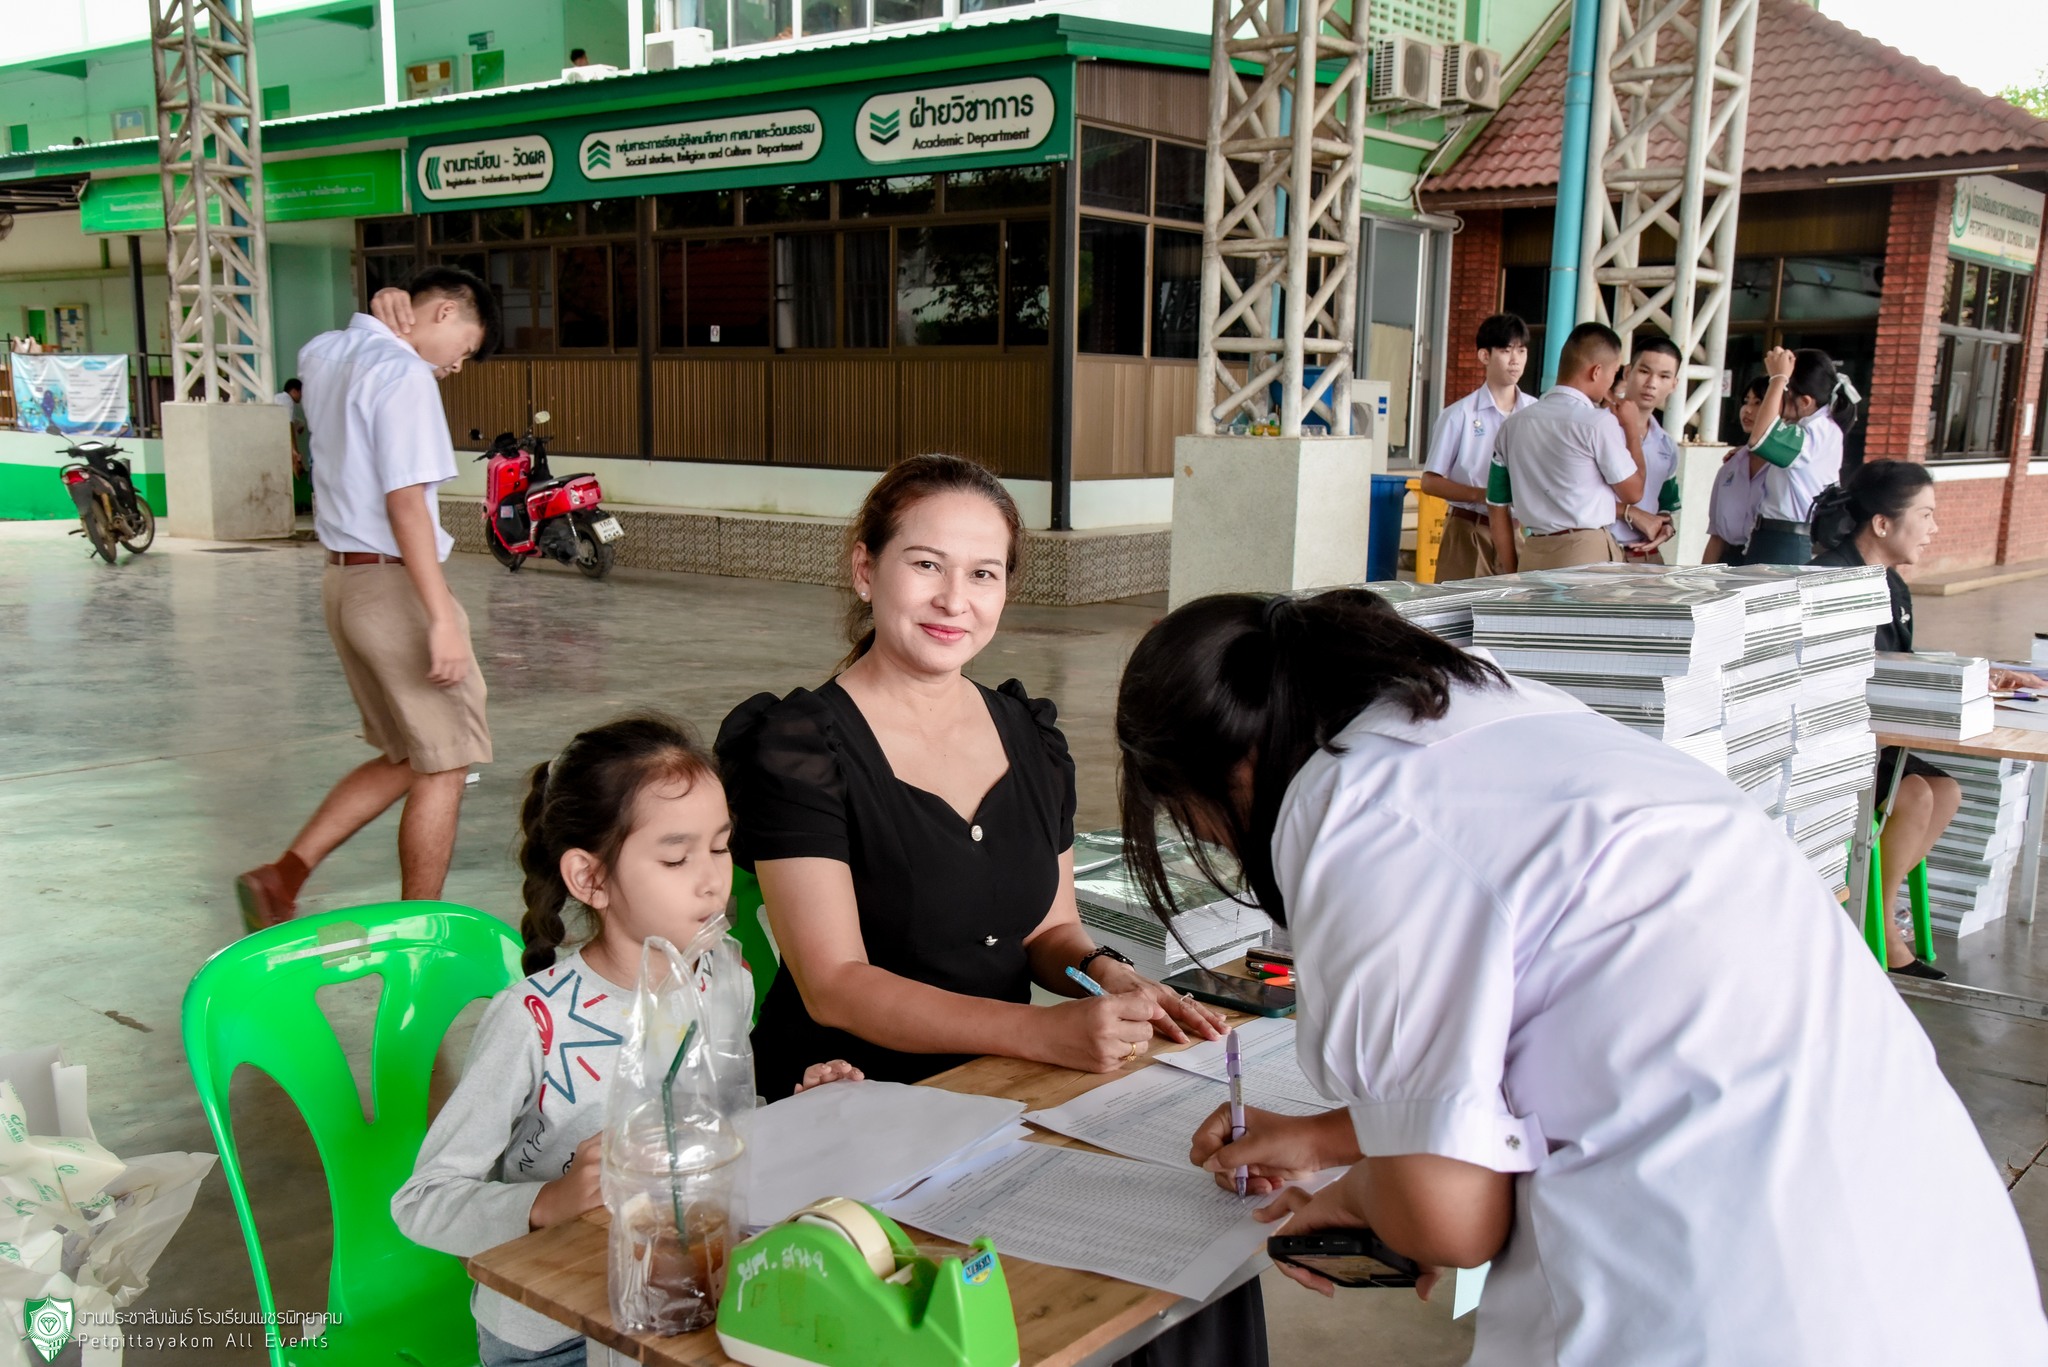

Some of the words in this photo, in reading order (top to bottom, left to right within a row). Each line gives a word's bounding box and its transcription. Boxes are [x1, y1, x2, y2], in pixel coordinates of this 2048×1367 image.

[910, 95, 1034, 128] ฝ่ายวิชาการ
[730, 122, 815, 142] ศาสนาและวัฒนธรรม
[912, 132, 964, 150] Academic
[967, 127, 1030, 148] Department
[443, 150, 500, 174] งานทะเบียน
[513, 147, 546, 167] วัดผล
[626, 154, 647, 167] Social
[677, 149, 705, 164] Religion
[708, 147, 722, 159] and
[724, 145, 752, 158] Culture
[757, 140, 803, 158] Department
[511, 171, 544, 184] Department
